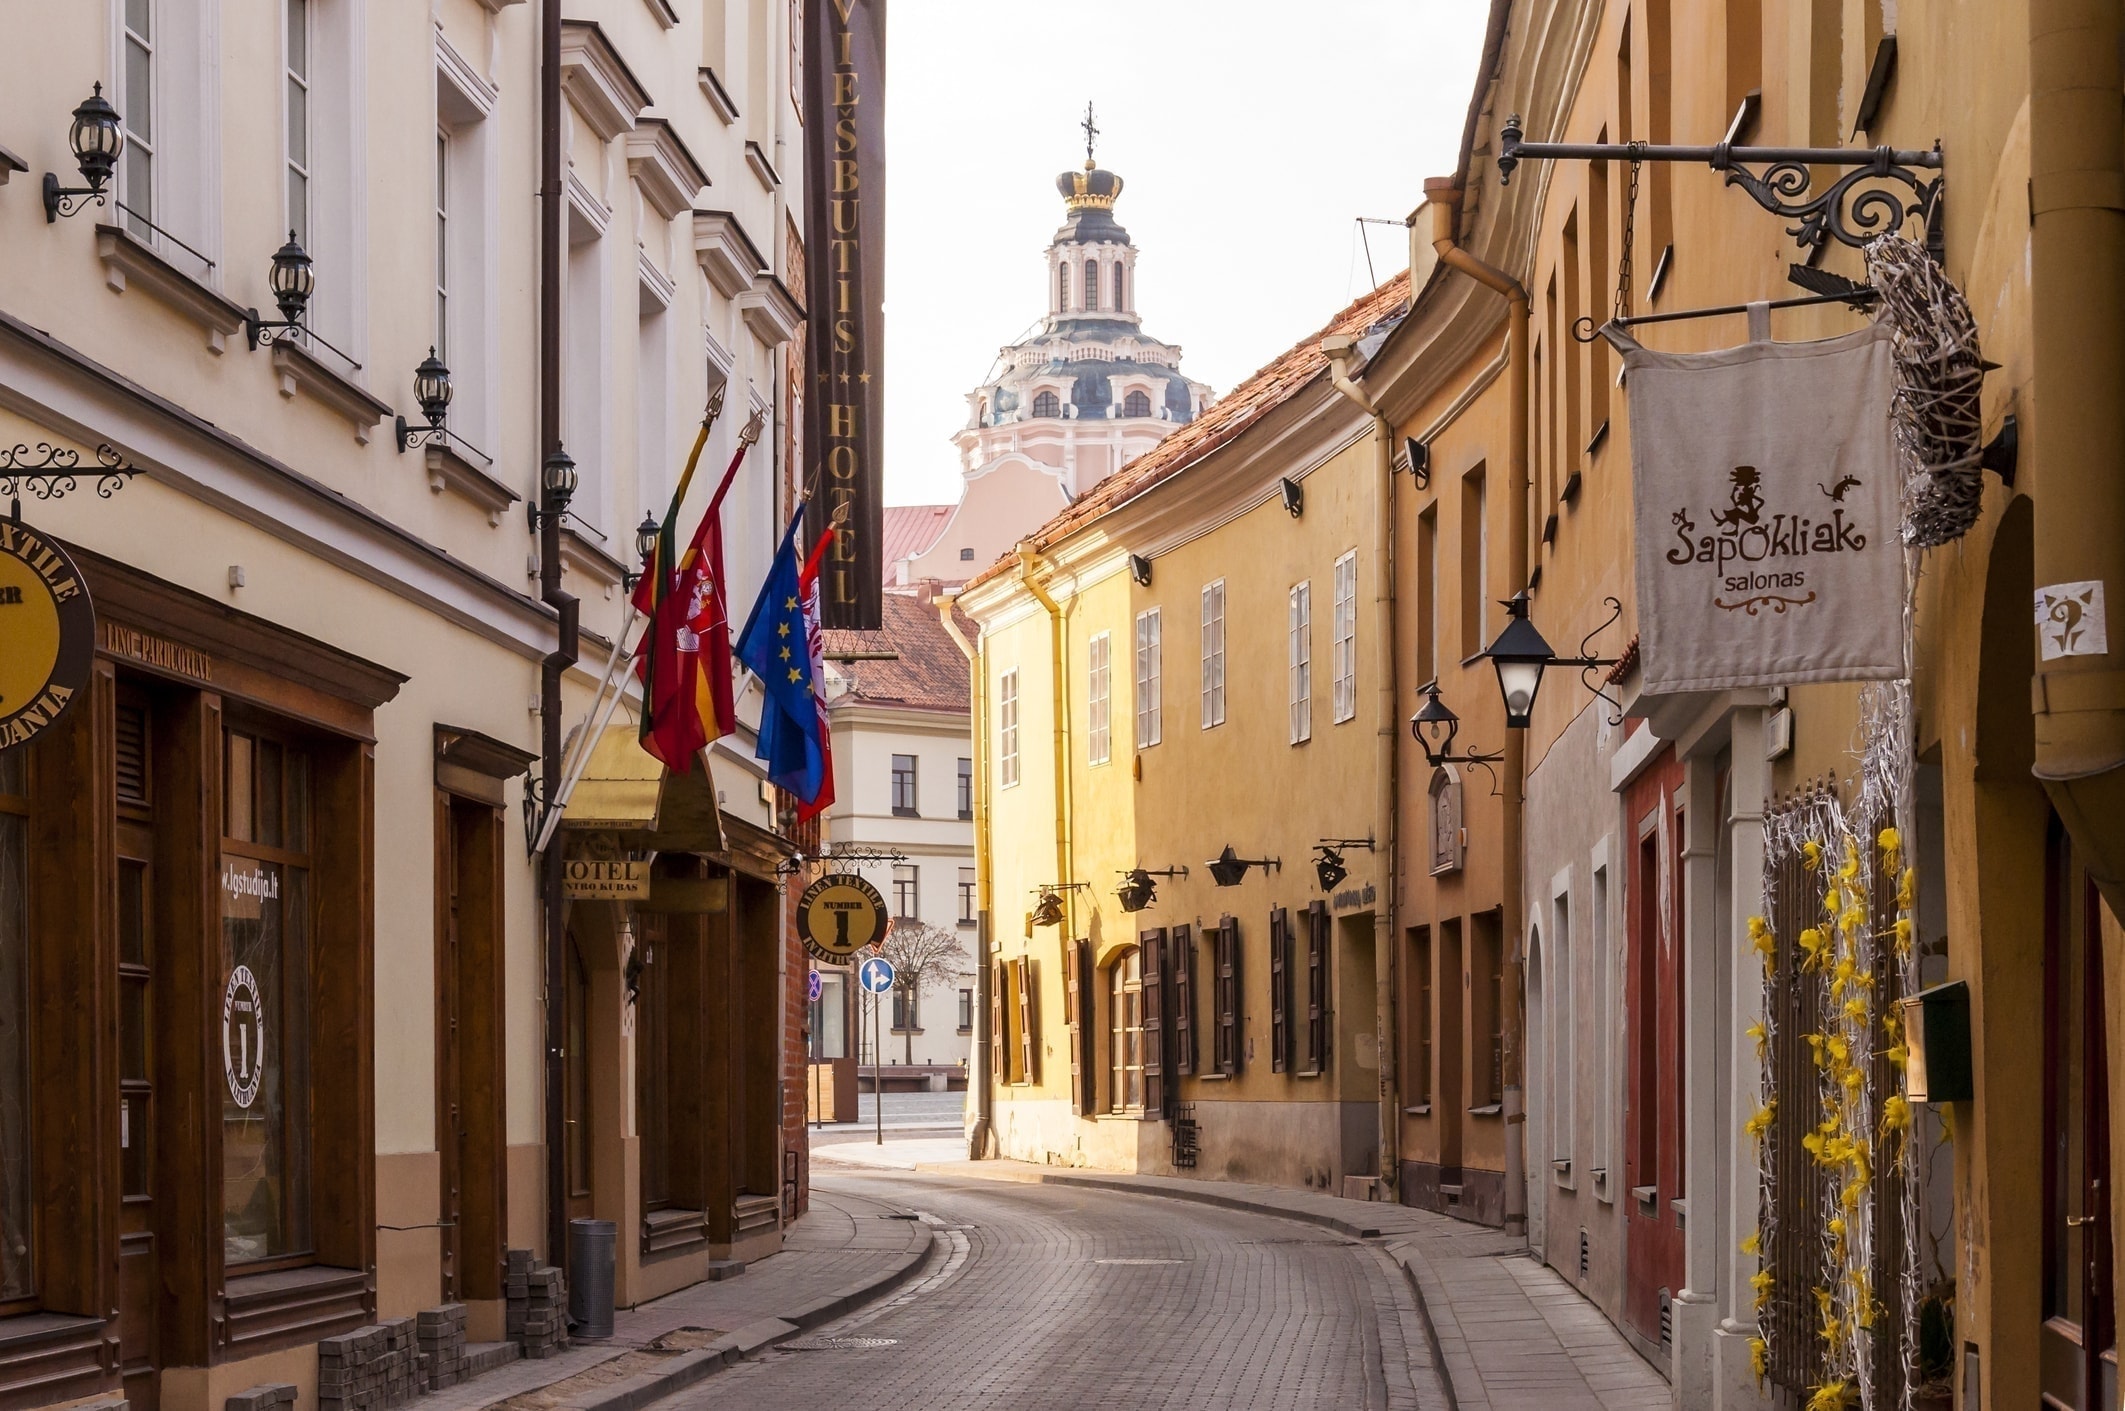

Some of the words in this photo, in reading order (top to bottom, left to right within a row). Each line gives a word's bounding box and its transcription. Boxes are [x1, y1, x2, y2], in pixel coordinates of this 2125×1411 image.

[828, 404, 860, 604] HOTEL
[1724, 571, 1805, 592] salonas
[599, 883, 639, 892] KUBAS
[800, 877, 833, 910] LINEN
[836, 876, 884, 910] TEXTILE
[823, 901, 863, 910] NUMBER
[832, 910, 852, 947] 1
[239, 1023, 249, 1079] 1
